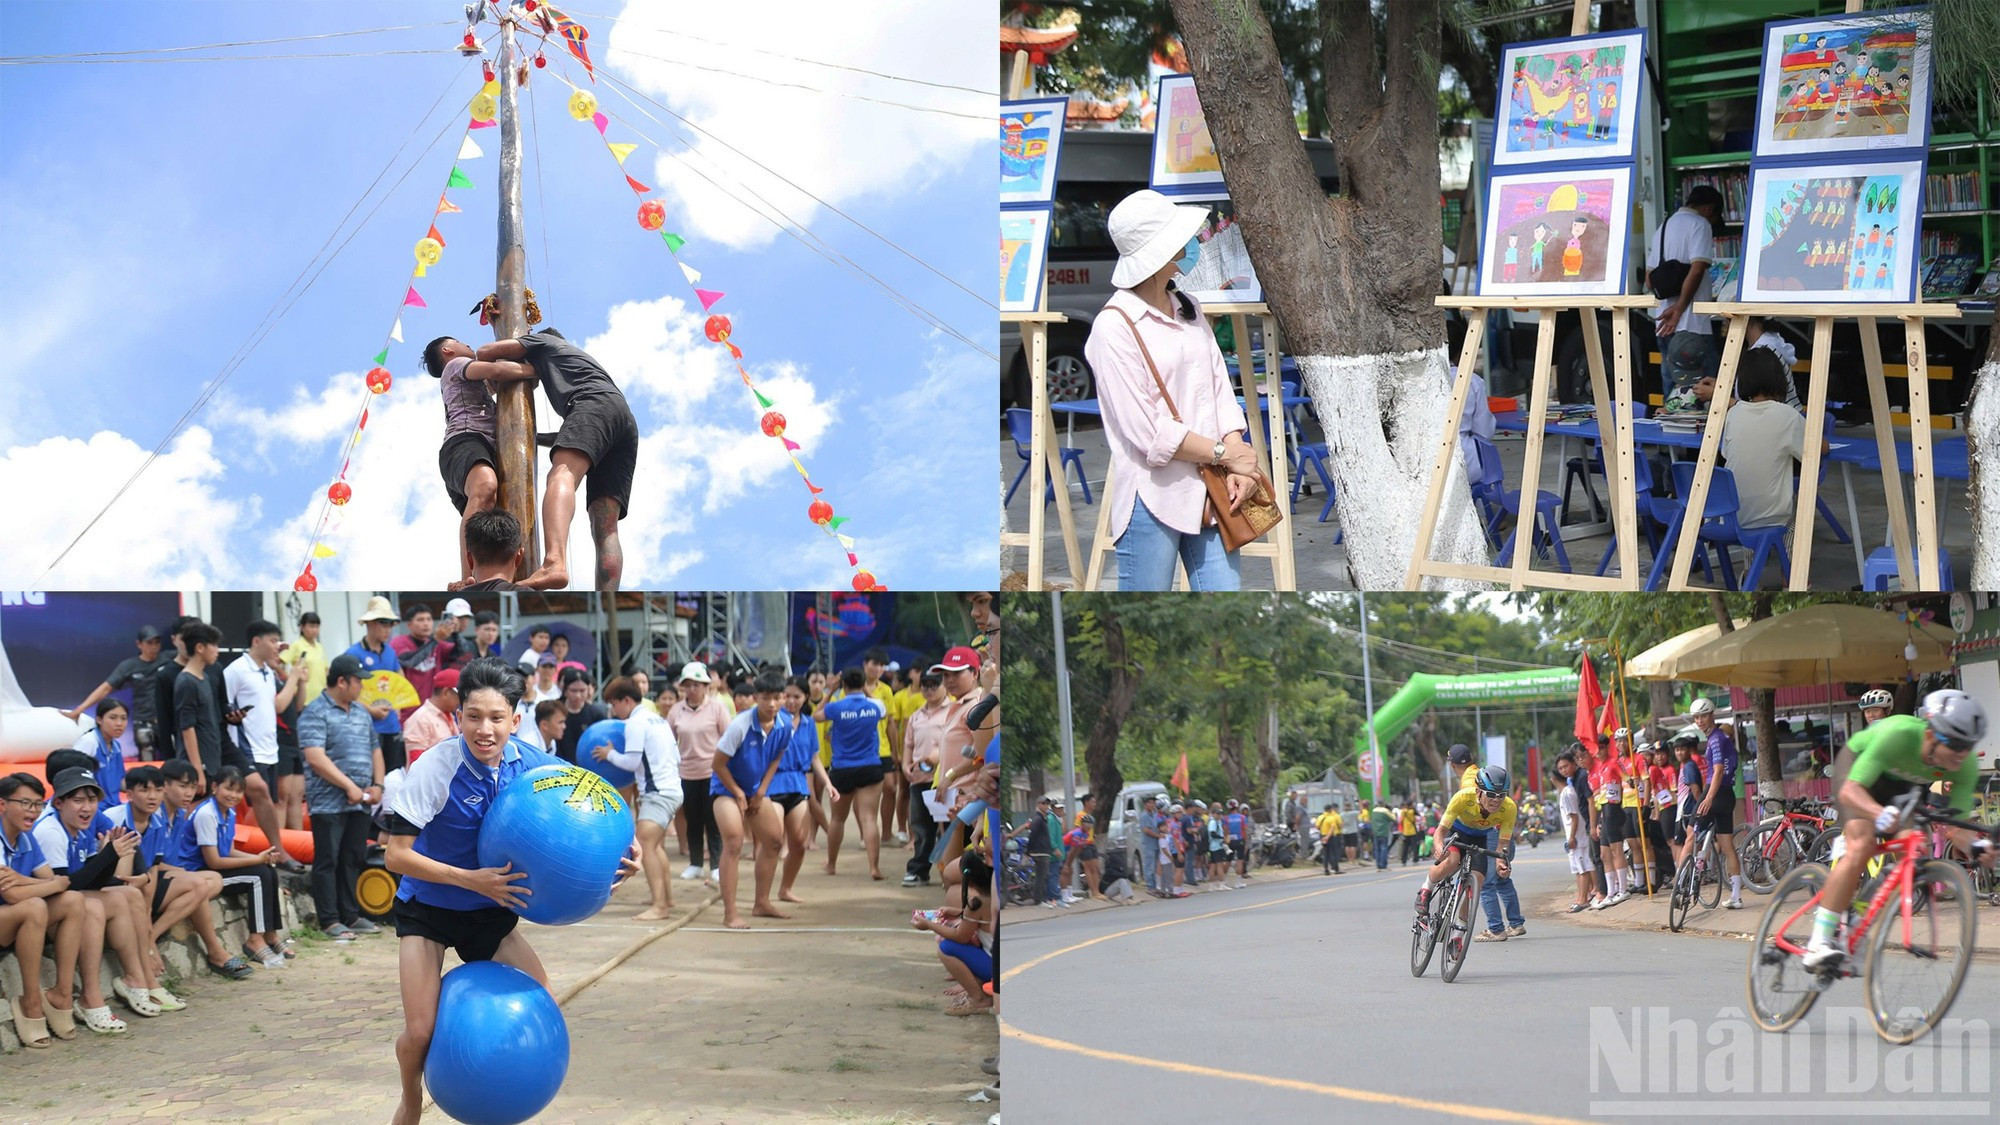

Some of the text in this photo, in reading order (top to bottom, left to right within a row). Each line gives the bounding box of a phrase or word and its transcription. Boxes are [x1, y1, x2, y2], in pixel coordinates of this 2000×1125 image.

[1047, 268, 1090, 285] 248.11
[841, 707, 877, 720] Kim Anh
